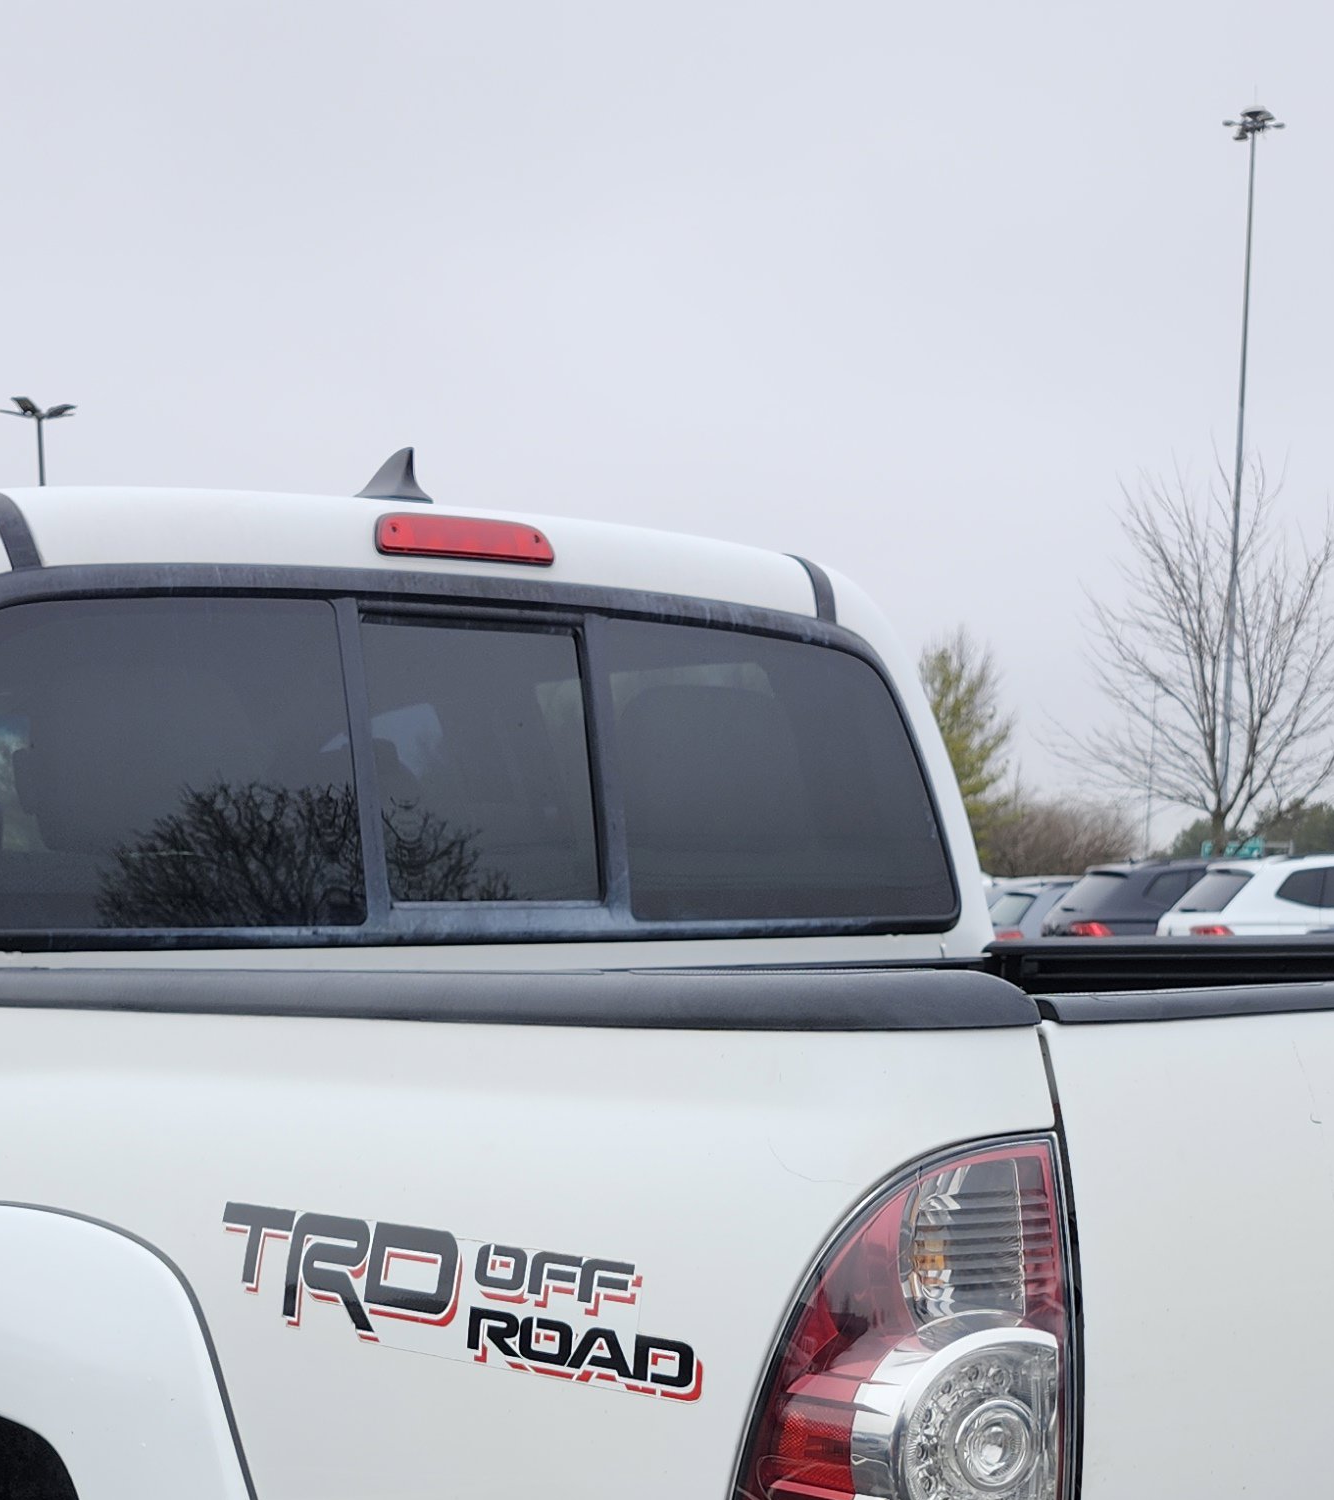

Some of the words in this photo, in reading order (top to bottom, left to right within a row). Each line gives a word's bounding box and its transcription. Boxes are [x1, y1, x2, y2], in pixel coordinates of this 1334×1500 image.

[223, 1201, 463, 1342] TRD
[474, 1243, 642, 1316] OFF
[467, 1305, 703, 1402] ROAD
